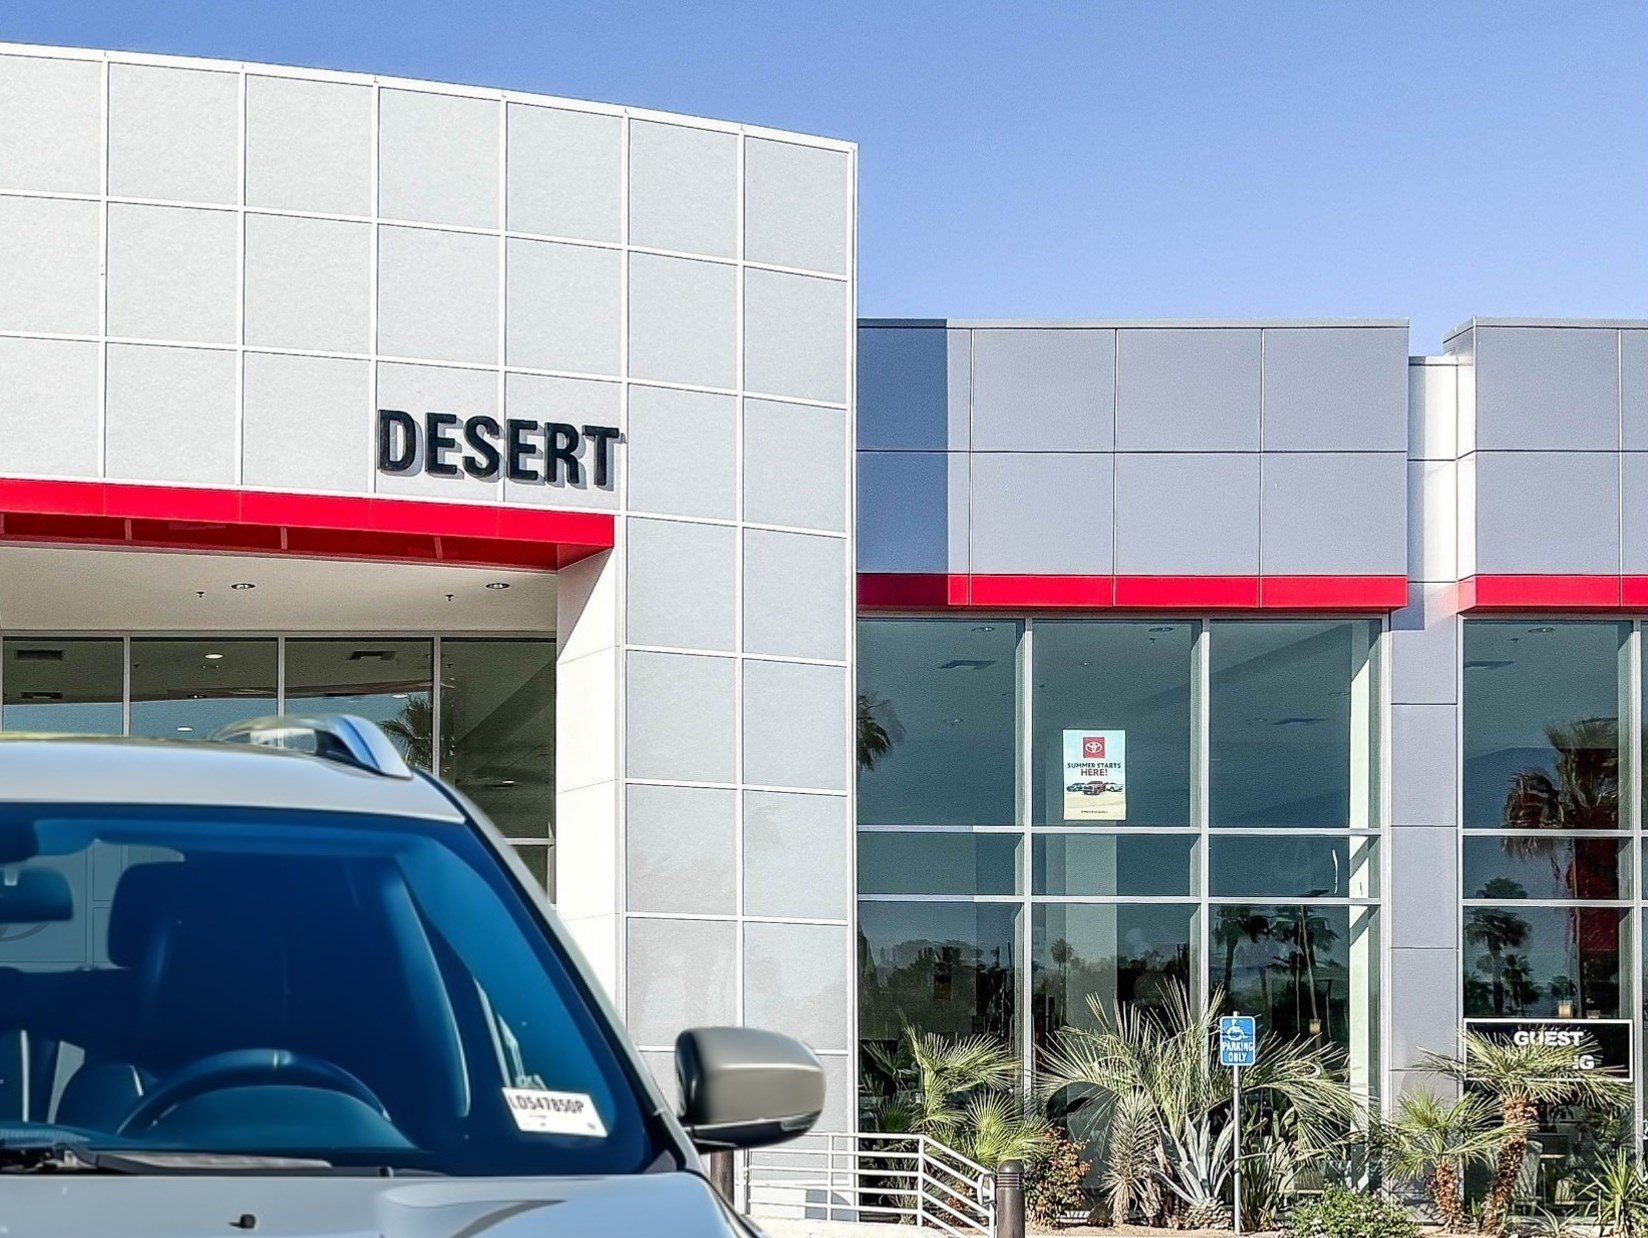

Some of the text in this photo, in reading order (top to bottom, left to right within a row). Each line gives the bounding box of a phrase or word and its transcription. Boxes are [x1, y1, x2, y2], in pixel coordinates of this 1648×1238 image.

[377, 409, 620, 487] DESERT
[1081, 768, 1108, 777] HERE!
[1513, 1030, 1585, 1047] GUEST
[1221, 1041, 1254, 1052] PARKING
[1228, 1052, 1247, 1062] ONLY
